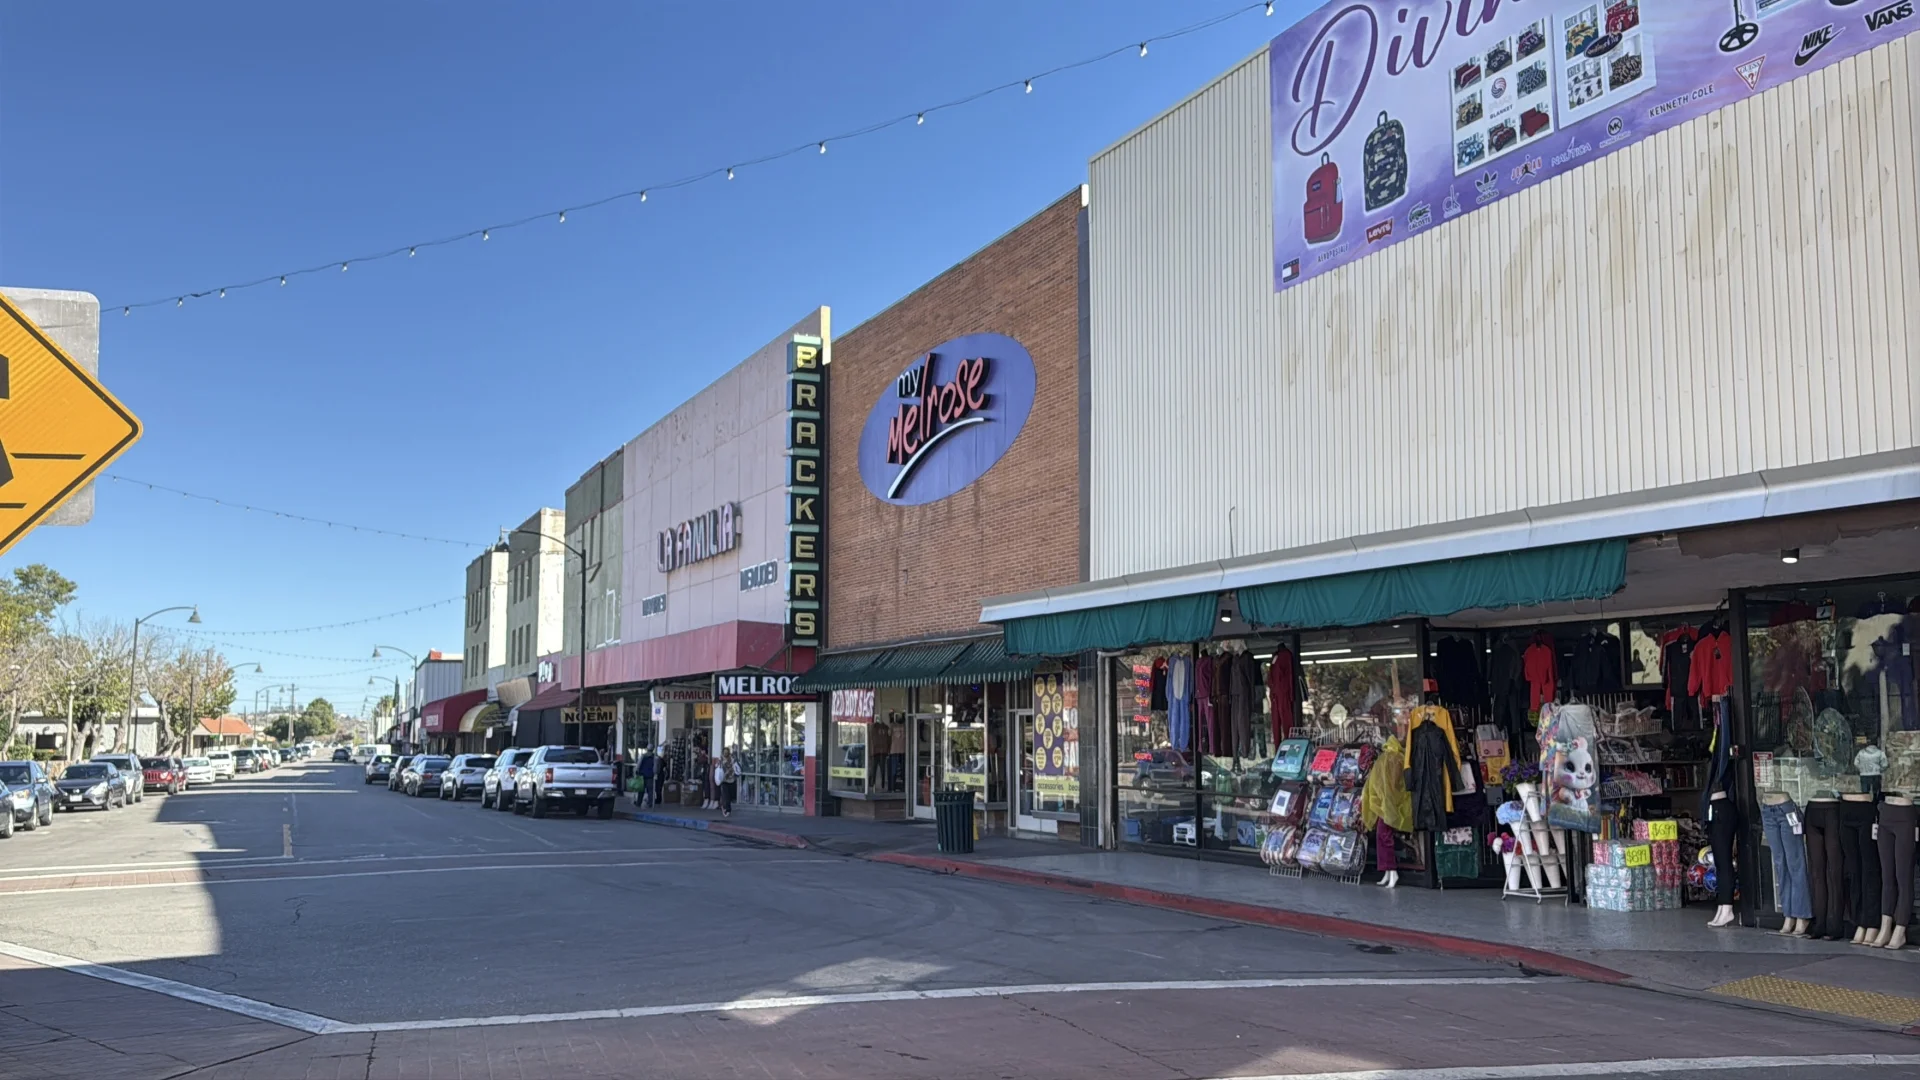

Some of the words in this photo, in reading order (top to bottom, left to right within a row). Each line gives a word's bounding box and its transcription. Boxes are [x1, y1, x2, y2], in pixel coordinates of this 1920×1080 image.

[1864, 0, 1913, 32] VANS
[1801, 24, 1833, 52] NIKE
[1489, 103, 1514, 120] BLANKET
[1649, 95, 1690, 119] KENNETH
[1692, 83, 1715, 101] COLE
[1476, 189, 1499, 204] adidas
[897, 365, 921, 398] my
[886, 352, 985, 465] Melrose
[794, 344, 818, 636] BRACKERS
[657, 528, 674, 573] LA
[675, 502, 735, 569] FAMILIA
[658, 690, 670, 700] LA
[718, 675, 817, 695] MELRO
[565, 711, 613, 722] NOEMI
[1037, 781, 1064, 791] accessories
